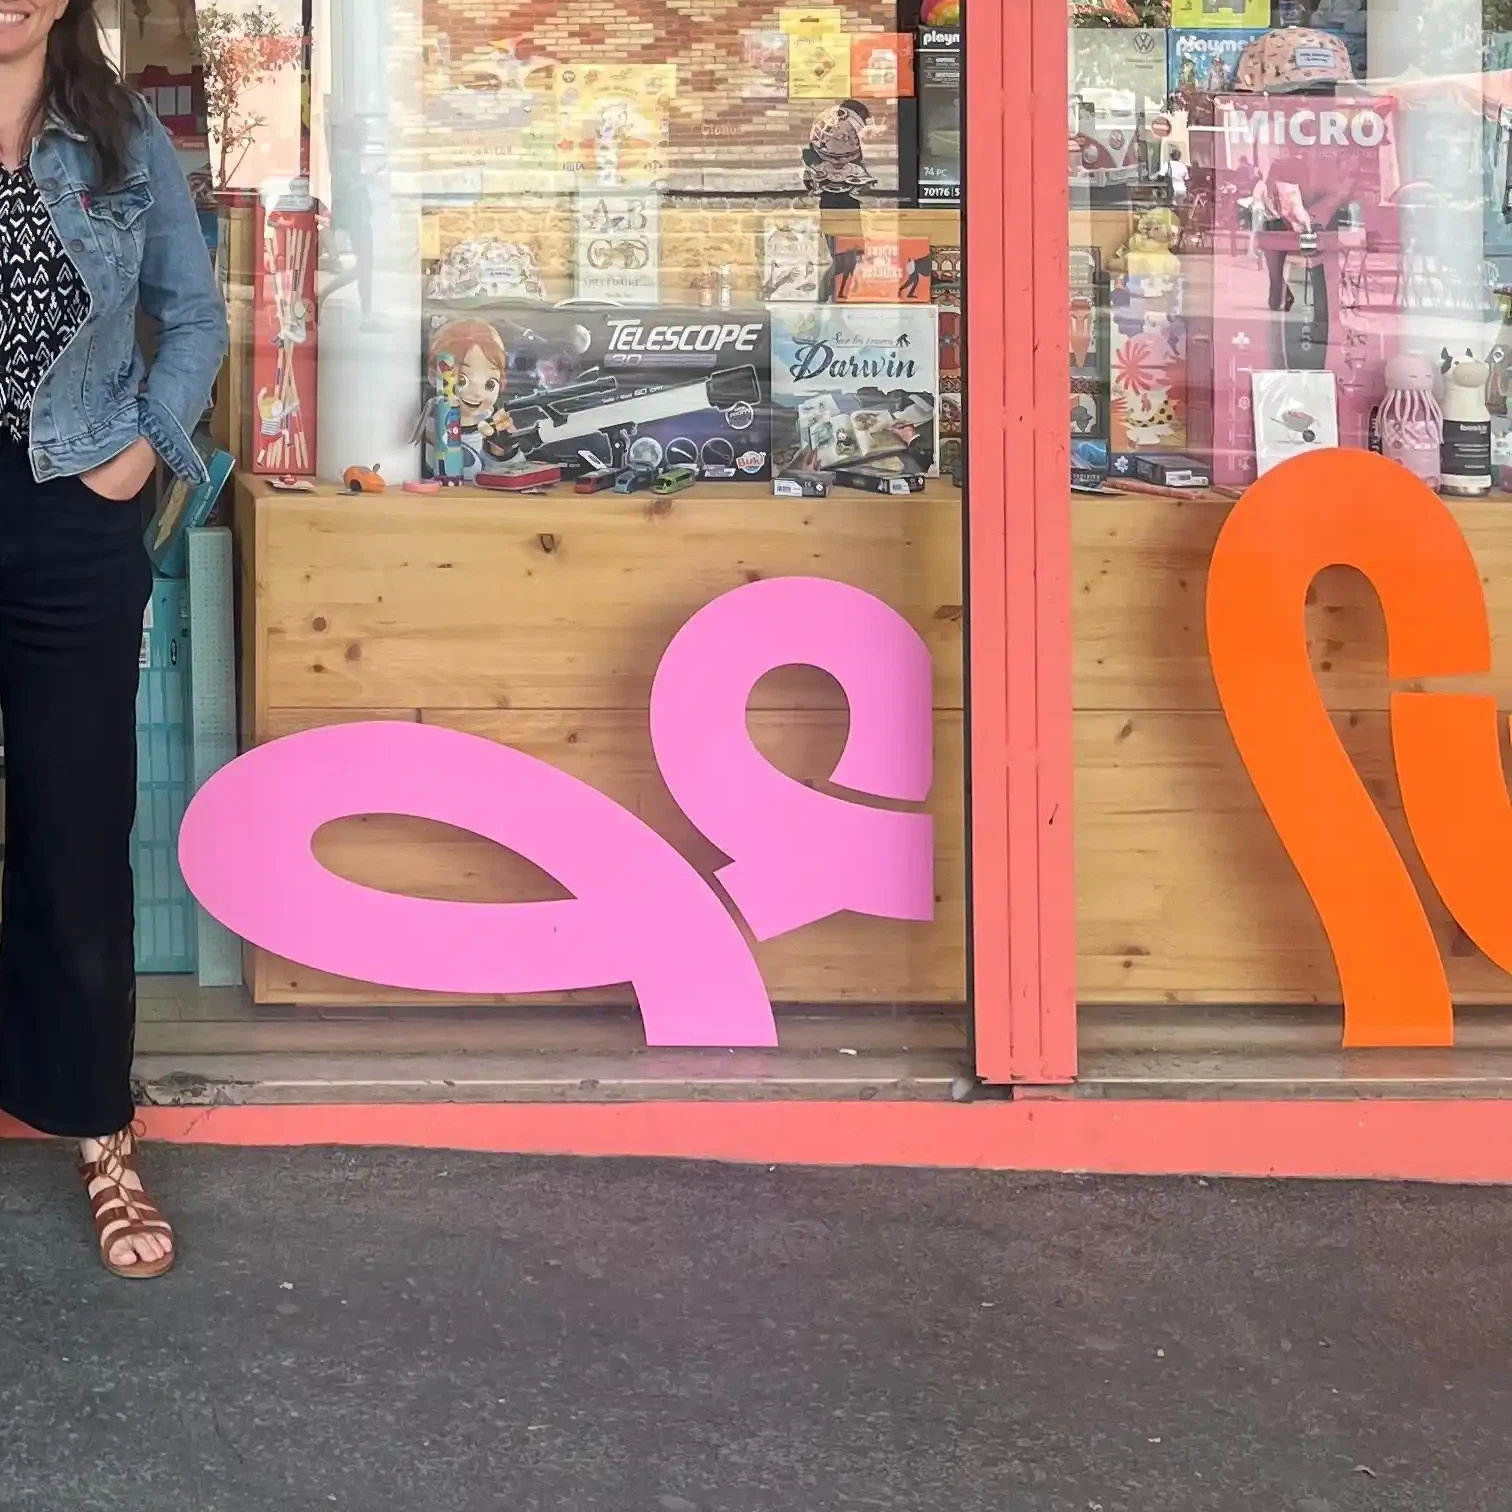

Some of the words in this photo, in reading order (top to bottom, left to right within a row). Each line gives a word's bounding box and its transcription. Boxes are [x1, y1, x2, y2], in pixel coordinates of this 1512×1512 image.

[923, 32, 960, 46] playm
[1175, 34, 1255, 57] playmo
[1231, 109, 1385, 147] MICRO
[924, 166, 935, 177] 74
[923, 187, 950, 197] 70176
[606, 319, 765, 351] TELESCOPE
[789, 339, 916, 383] Darwin
